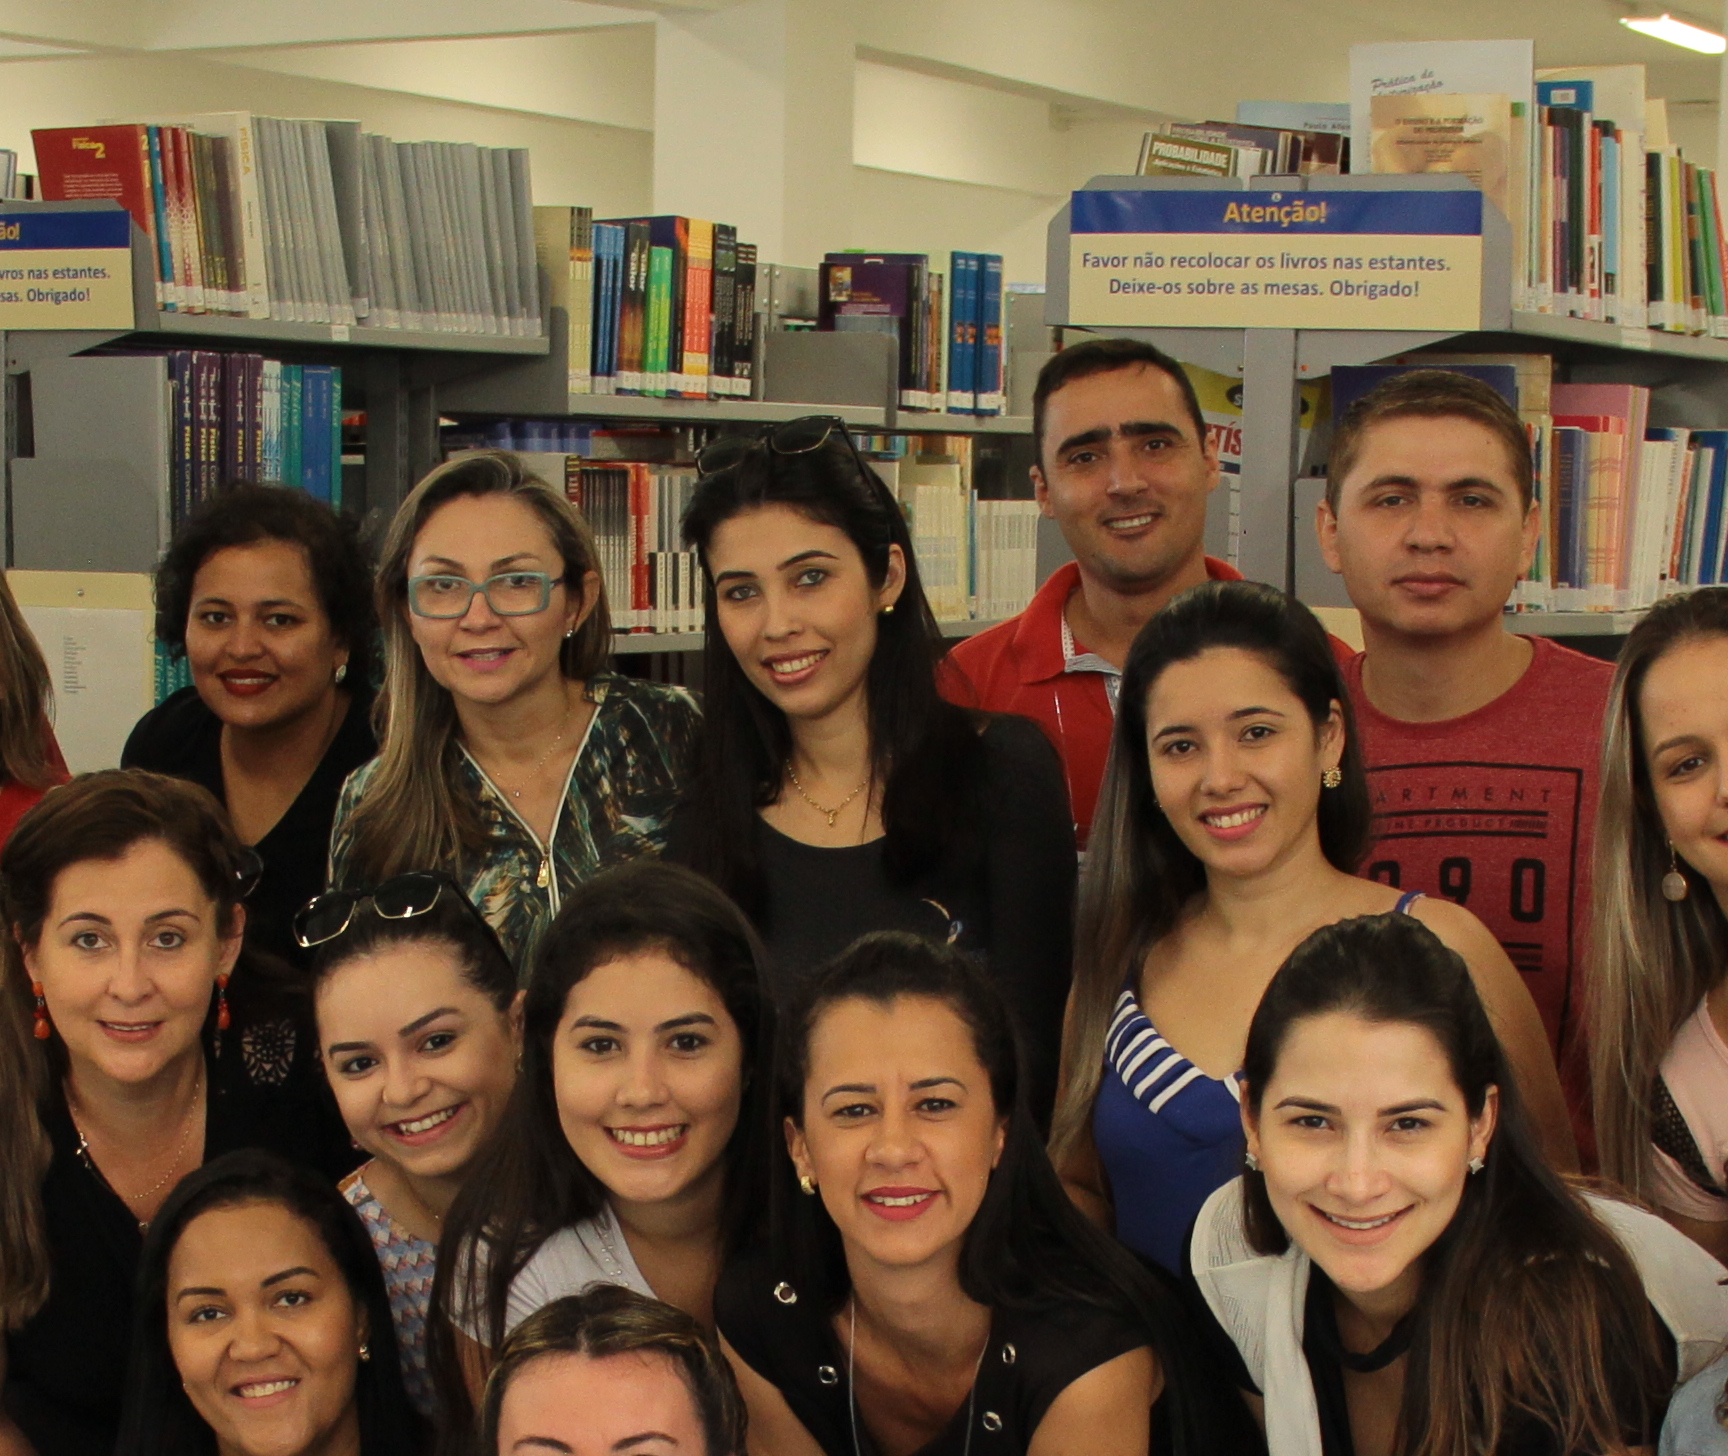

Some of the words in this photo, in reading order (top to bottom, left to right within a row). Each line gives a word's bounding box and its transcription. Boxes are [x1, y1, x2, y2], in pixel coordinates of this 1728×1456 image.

[95, 143, 106, 158] 2
[1152, 141, 1229, 168] PROBABILIDADE
[1223, 200, 1328, 228] Atenção!
[1082, 252, 1129, 269] Favor
[1133, 251, 1165, 269] não
[1170, 251, 1251, 269] recolocar
[1256, 256, 1276, 270] os
[1280, 252, 1328, 270] livros
[1333, 257, 1363, 270] nas
[1368, 255, 1451, 271] estantes.
[28, 268, 49, 280] nas
[52, 266, 111, 280] estantes.
[27, 288, 91, 306] Obrigado!
[1109, 278, 1182, 295] Deixe-os
[1186, 278, 1235, 295] sobre
[1240, 283, 1258, 295] as
[1264, 283, 1325, 296] mesas.
[1329, 279, 1420, 300] Obrigado!
[1425, 817, 1505, 829] PRODUCT
